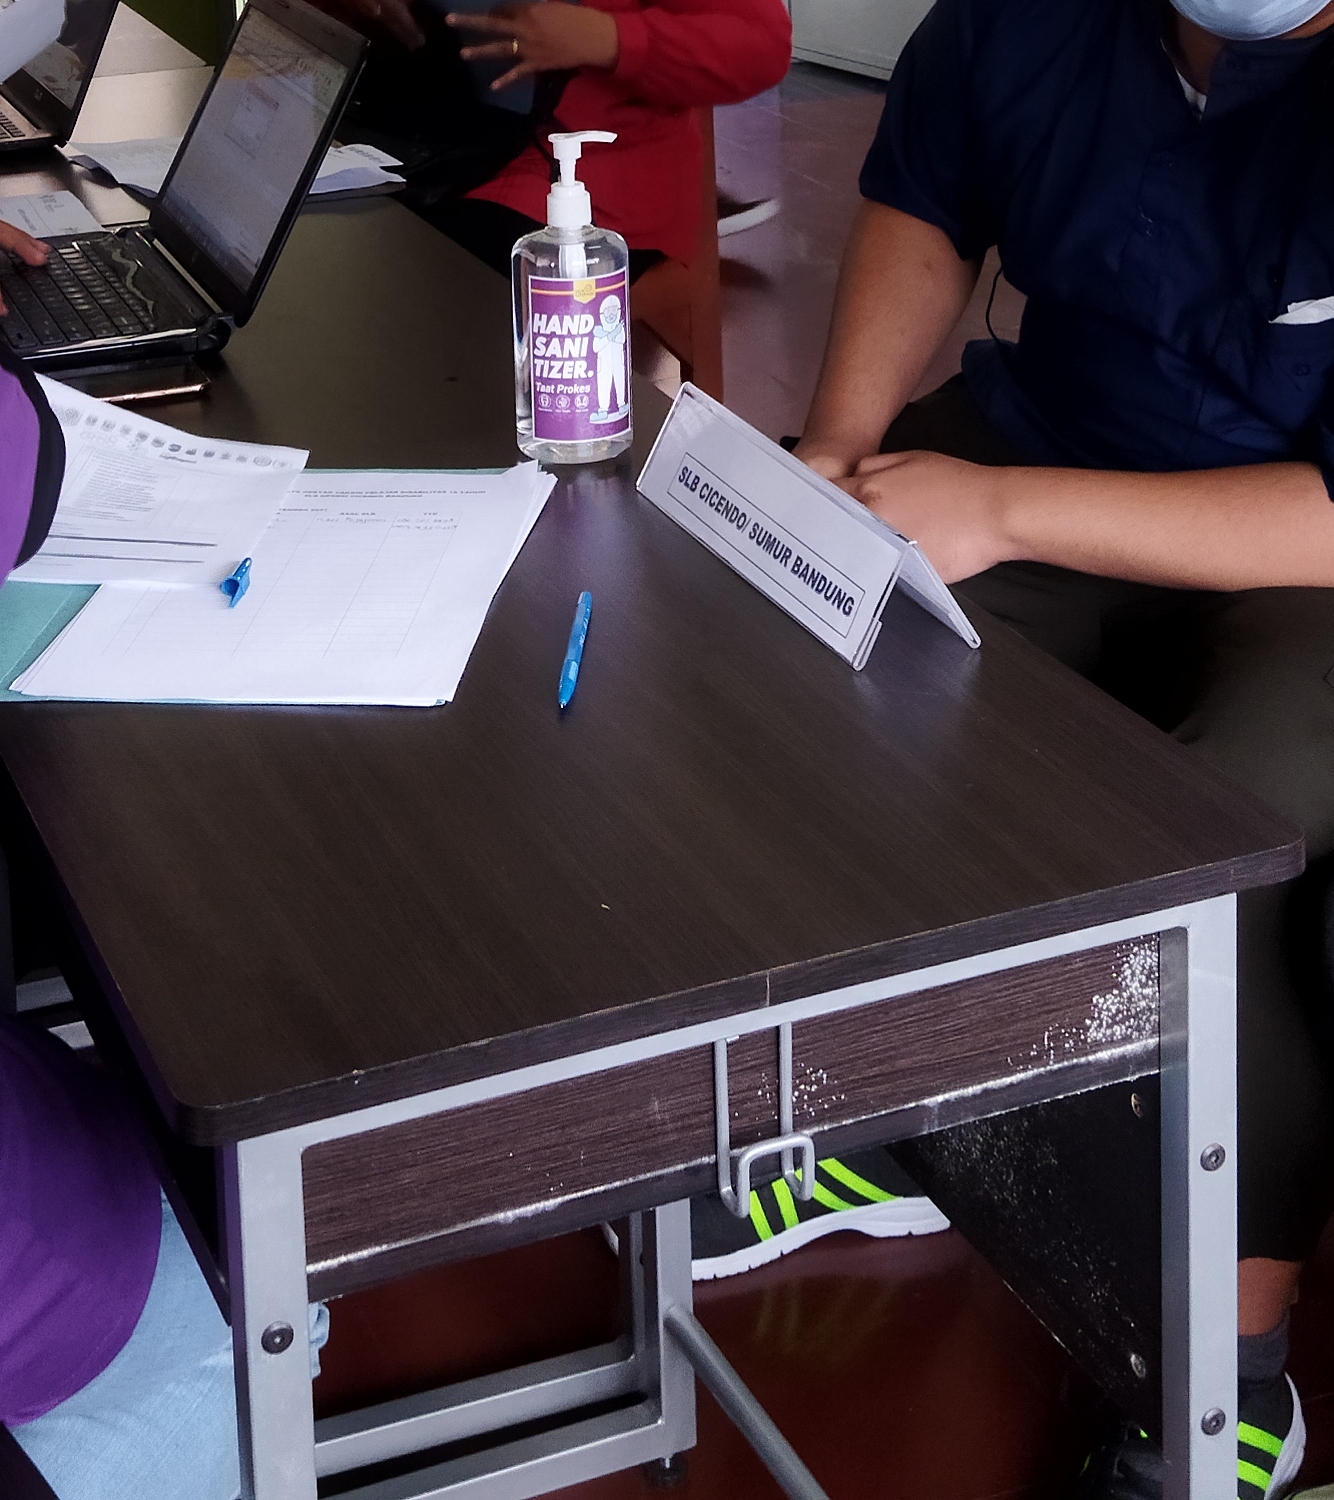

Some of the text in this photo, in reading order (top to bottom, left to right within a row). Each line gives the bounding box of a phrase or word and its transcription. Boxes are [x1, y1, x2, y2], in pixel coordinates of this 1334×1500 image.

[533, 313, 595, 335] HAND
[534, 336, 589, 358] SANI
[534, 359, 594, 379] TIZER.
[557, 383, 591, 394] Prokes
[678, 465, 855, 617] SLB CICENDO/ SUMUR BANDUNG
